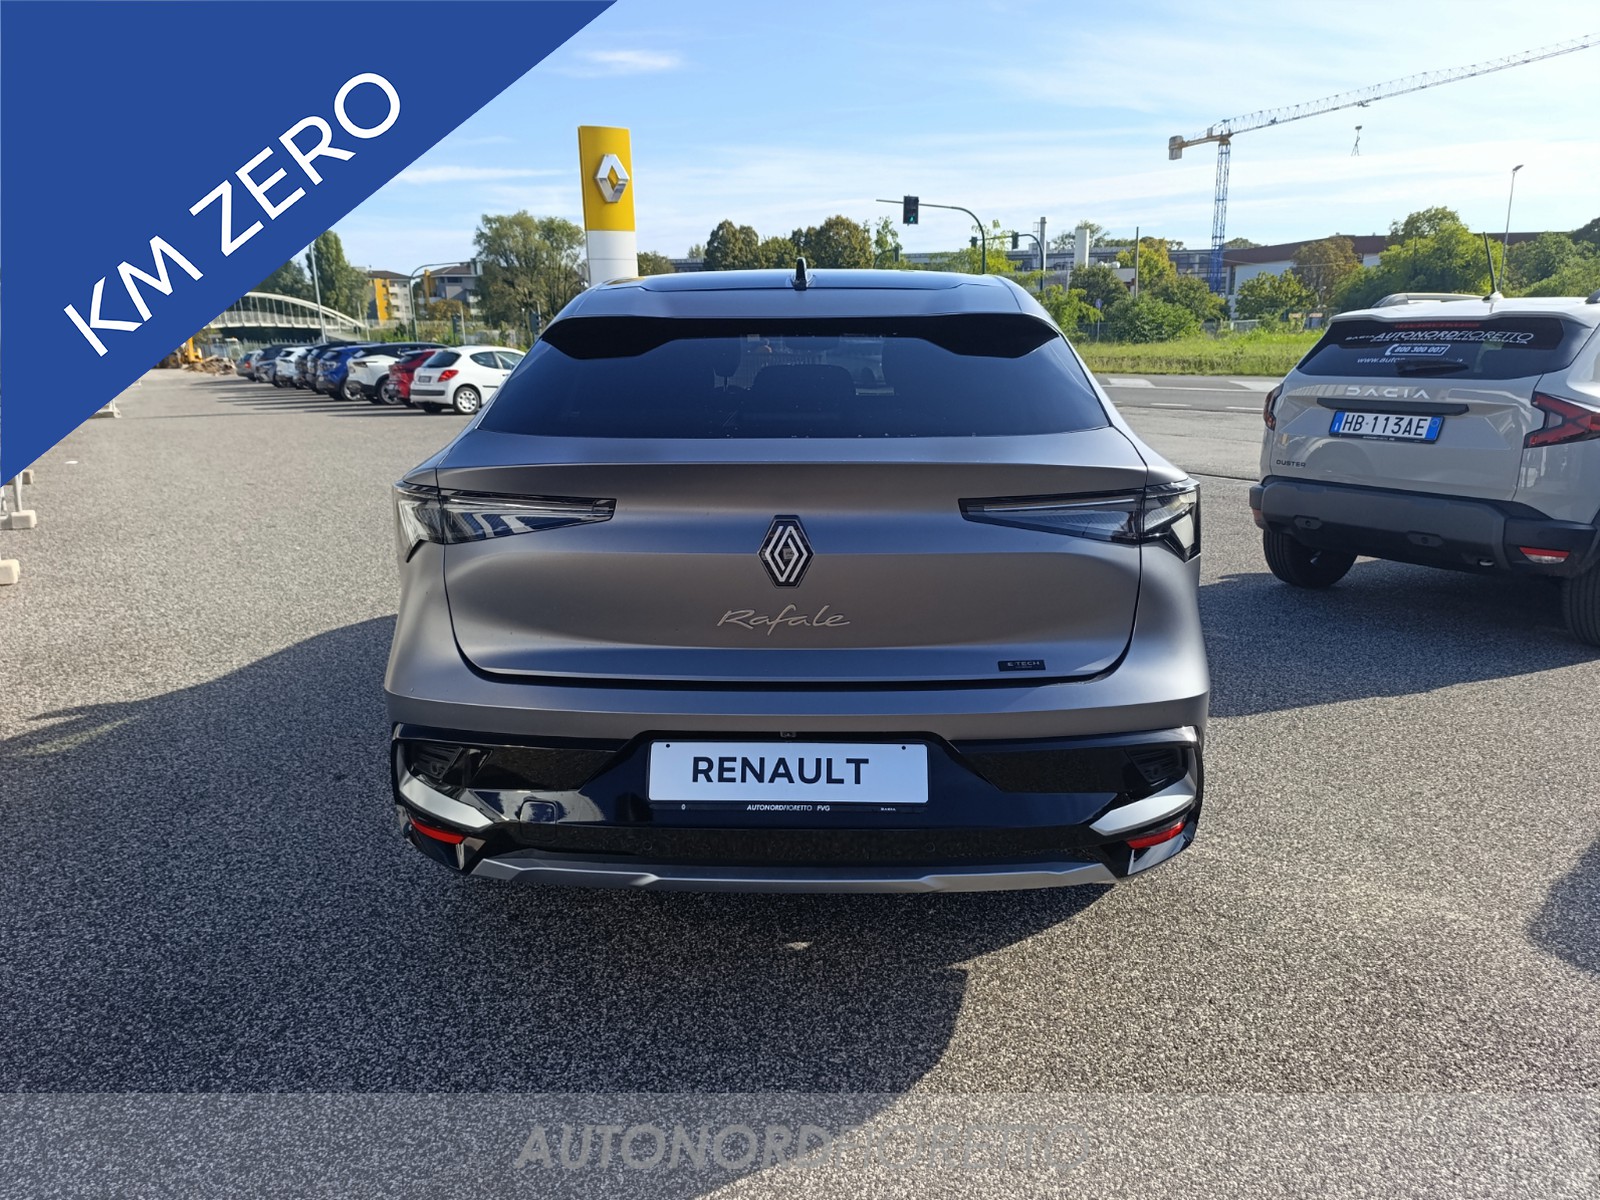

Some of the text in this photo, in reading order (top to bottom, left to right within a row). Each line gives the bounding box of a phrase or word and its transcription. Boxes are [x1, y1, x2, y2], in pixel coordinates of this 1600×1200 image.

[1373, 330, 1534, 342] AUTONORDFIORETTO
[1345, 387, 1430, 400] DACIA
[1275, 459, 1306, 468] DUSTER
[716, 603, 851, 636] Rafale
[691, 756, 870, 785] RENAULT
